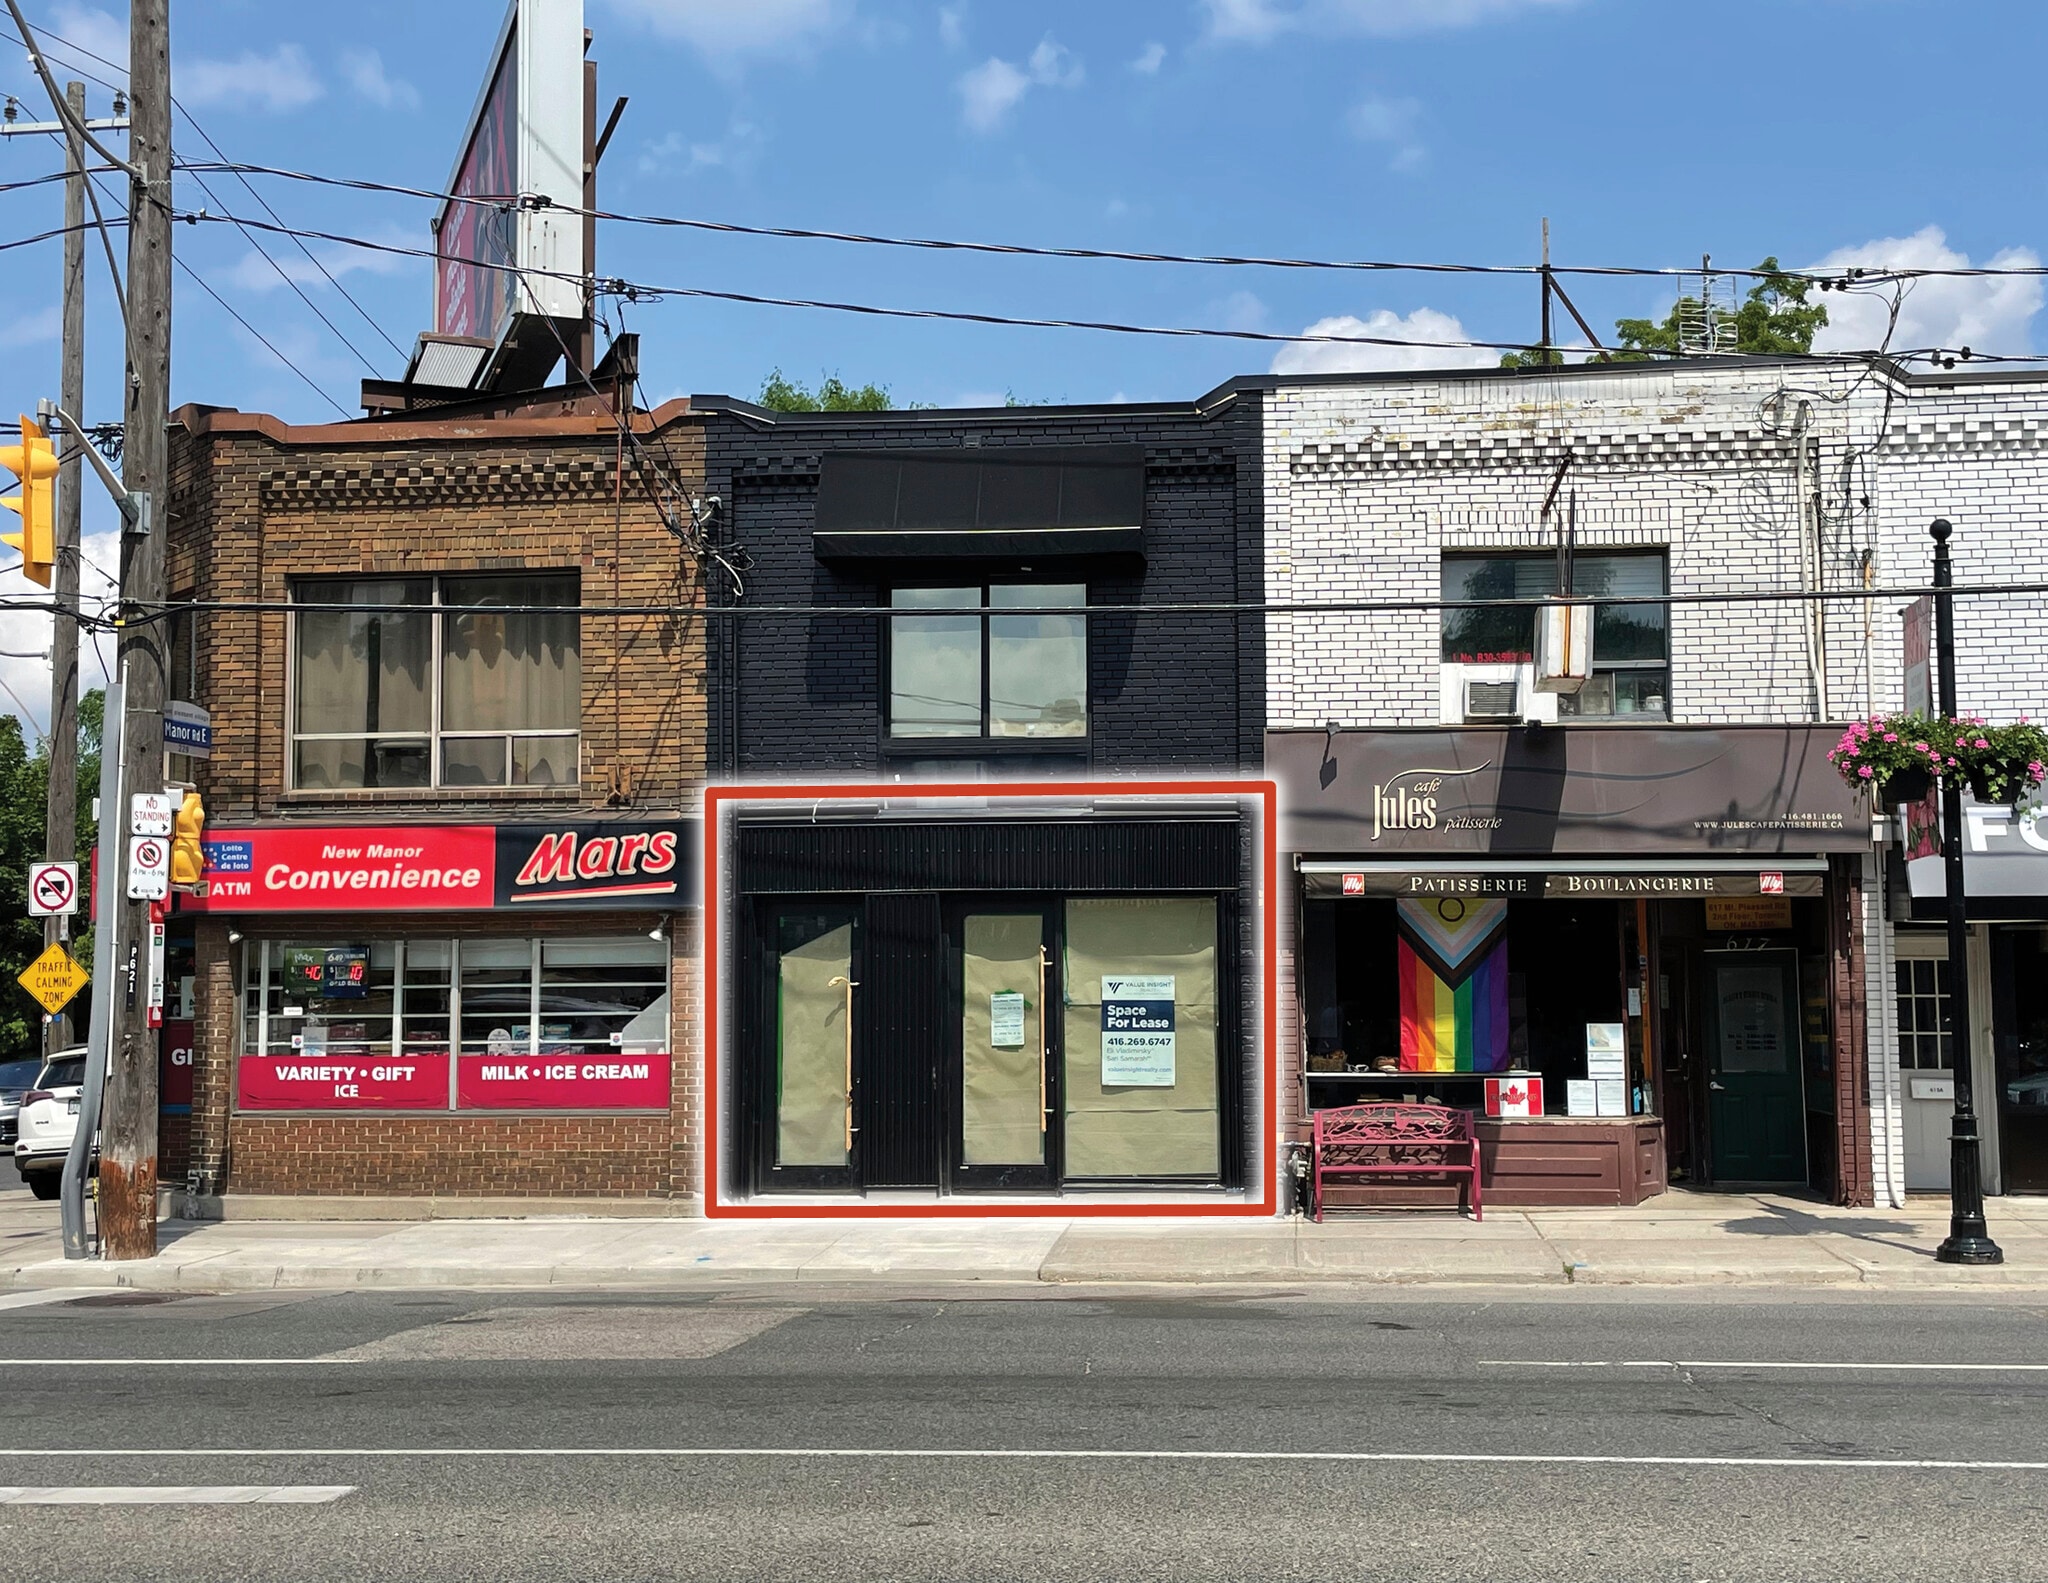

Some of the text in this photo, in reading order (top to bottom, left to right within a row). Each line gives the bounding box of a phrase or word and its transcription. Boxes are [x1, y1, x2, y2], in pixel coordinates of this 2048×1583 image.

[164, 721, 191, 740] Manor
[201, 728, 207, 743] E
[145, 799, 158, 809] NO
[134, 811, 170, 822] STANDING
[1370, 784, 1437, 841] Jules
[1781, 812, 1844, 820] 416.481.1666
[1693, 820, 1844, 829] WWW.JULESCAFEPATISSERIE.CA
[221, 844, 244, 852] Lotto
[321, 844, 424, 859] New Manor
[221, 852, 249, 861] Centre
[514, 830, 678, 886] Mars
[221, 861, 249, 870] de loto
[264, 862, 481, 891] Convenience
[1410, 875, 1714, 892] PATISSERIE BOULANGERIE
[1760, 874, 1783, 891] illy
[211, 881, 251, 896] ATM
[1343, 876, 1364, 893] illy
[1726, 935, 1771, 951] 617
[37, 961, 72, 973] TRAFFIC
[127, 946, 138, 993] P621
[305, 966, 322, 980] 40
[350, 966, 363, 980] 10
[35, 976, 73, 988] CALMING
[43, 991, 65, 1003] ZONE
[1107, 1004, 1147, 1018] Space
[1107, 1017, 1169, 1028] For Lease
[1107, 1037, 1172, 1046] 416.269.6747
[275, 1065, 416, 1081] VARIETY GIFT
[481, 1063, 649, 1081] MILK ICE CREAM
[334, 1084, 360, 1098] ICE
